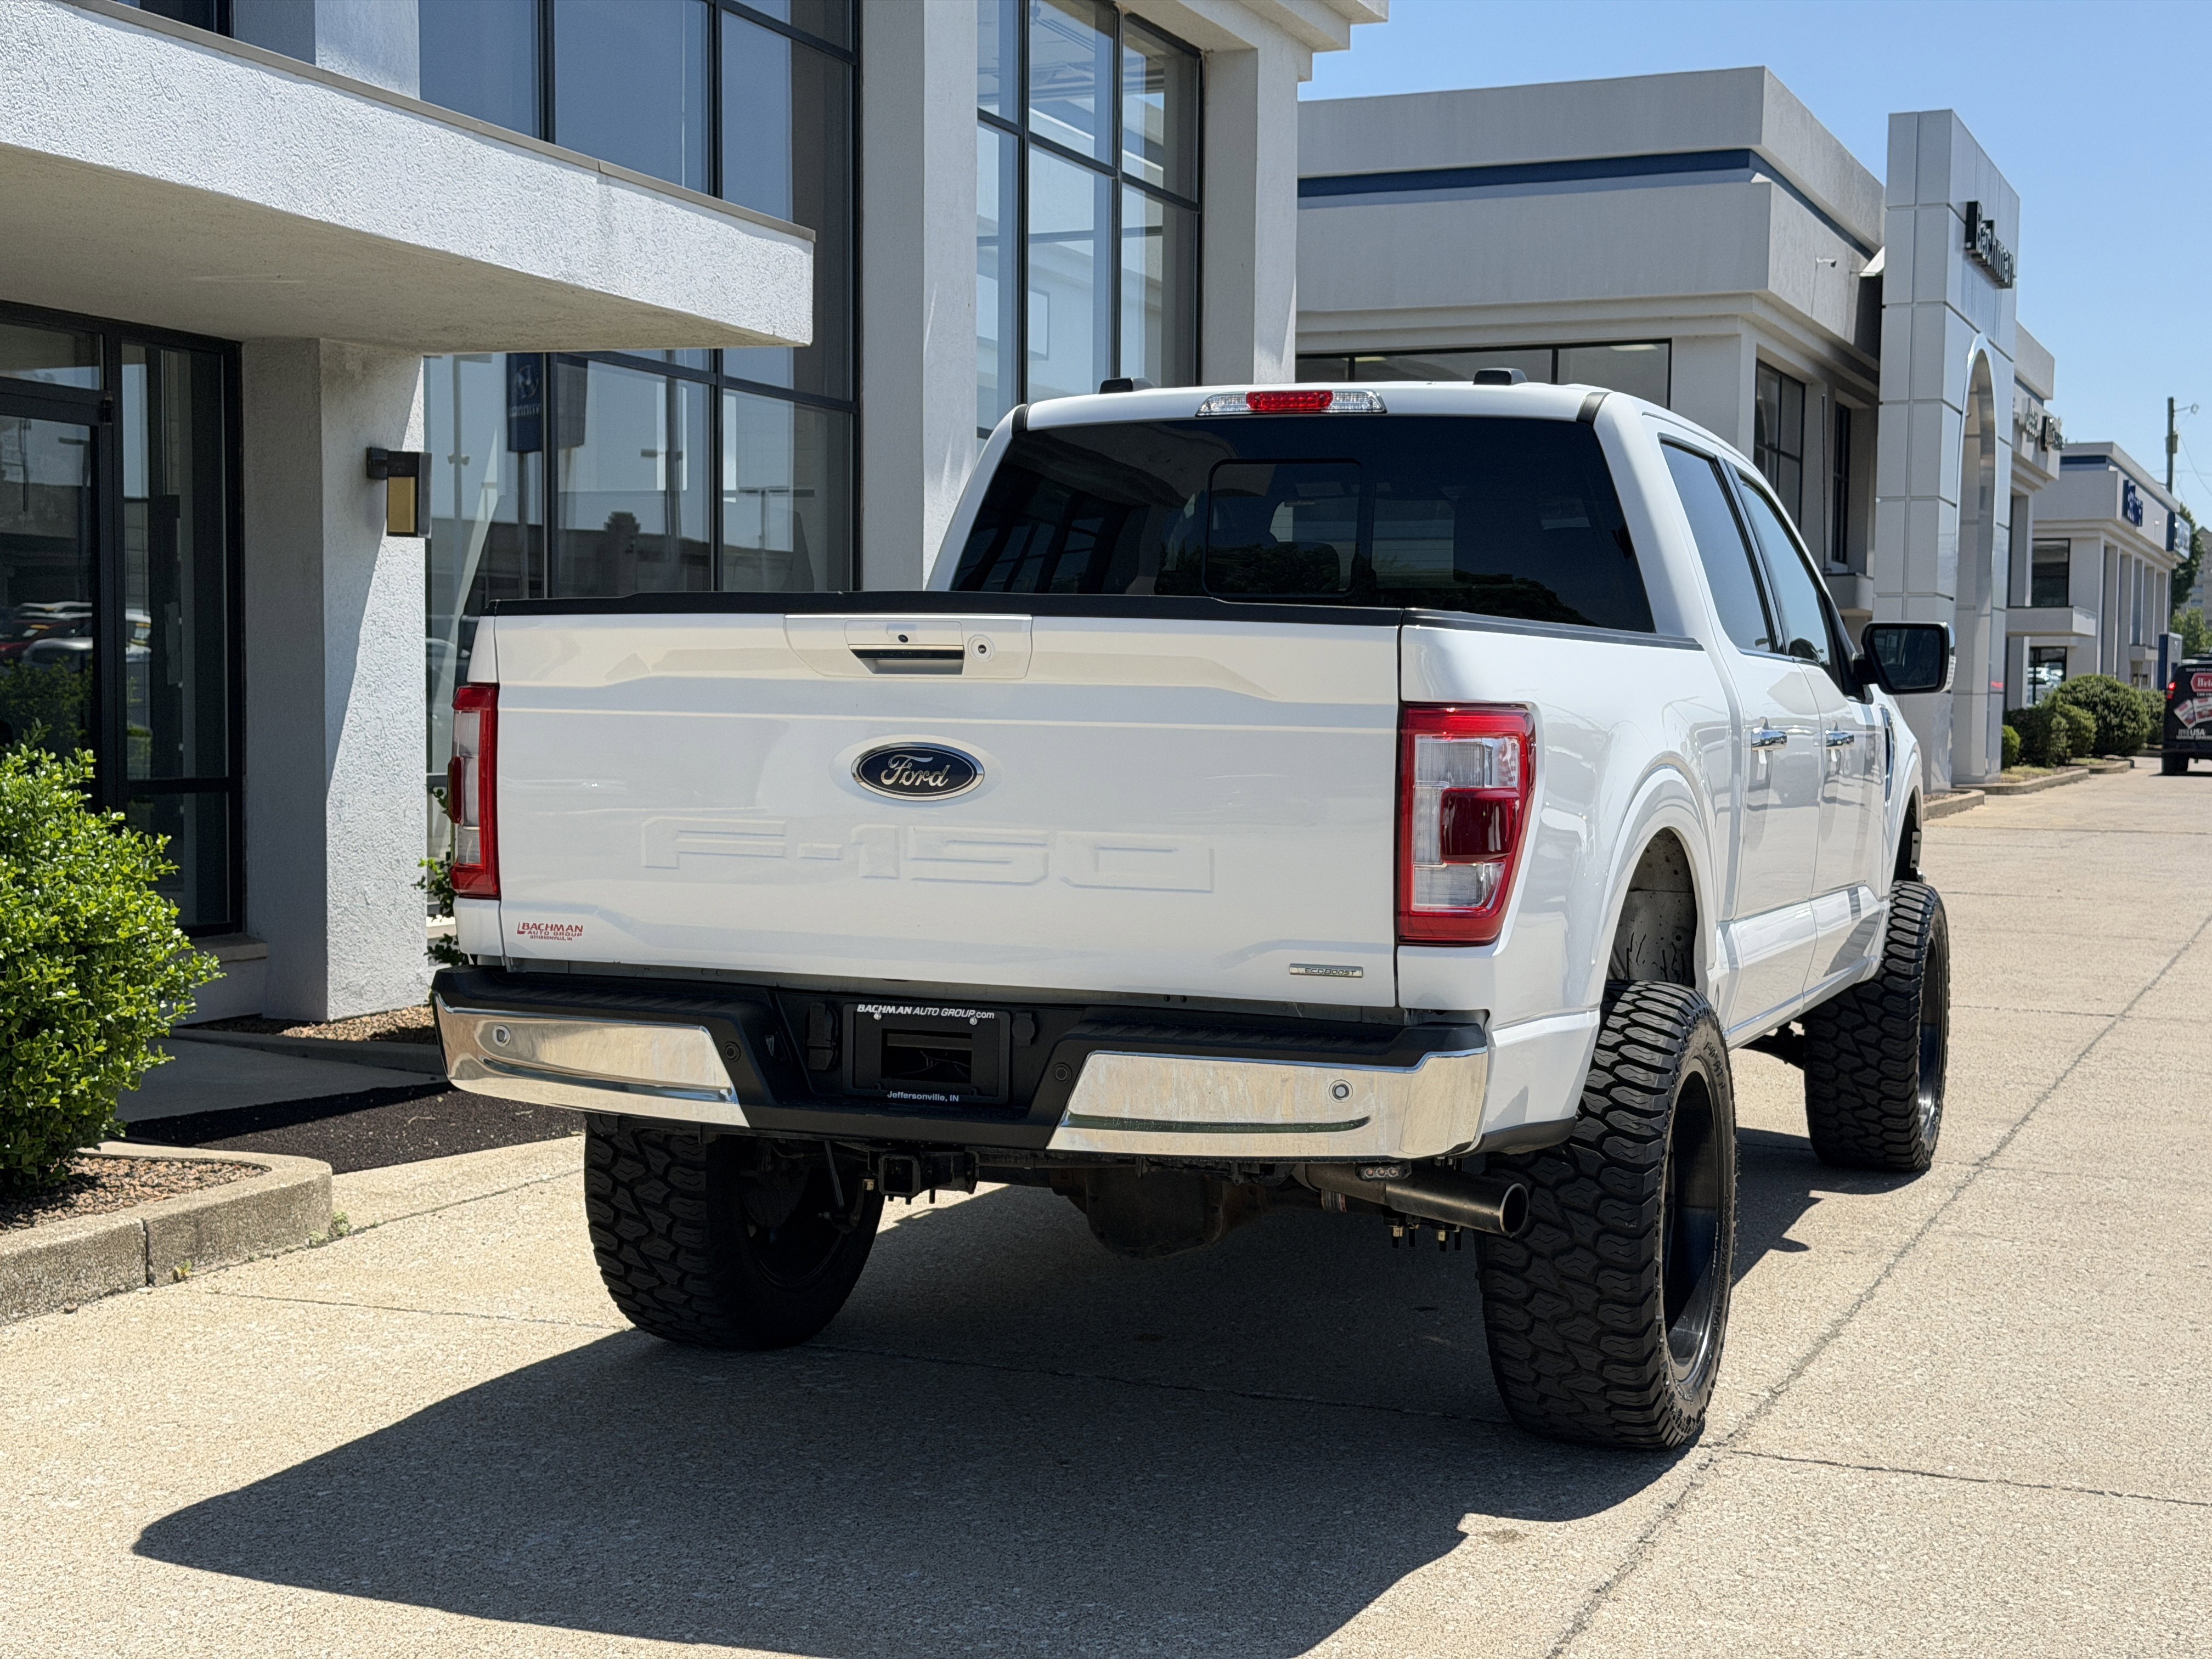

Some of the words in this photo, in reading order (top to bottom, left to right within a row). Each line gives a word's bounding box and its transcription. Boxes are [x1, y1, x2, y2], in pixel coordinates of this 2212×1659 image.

[1966, 201, 2014, 289] Bachman
[880, 754, 951, 787] Ford
[640, 816, 1215, 894] F-150
[522, 922, 583, 933] BACHMAN
[856, 1004, 913, 1015] BACHMAN
[912, 1007, 940, 1016] AUTO
[941, 1008, 995, 1019] GROUP.com
[887, 1090, 948, 1102] Jeffersonville,
[950, 1094, 960, 1102] IN
